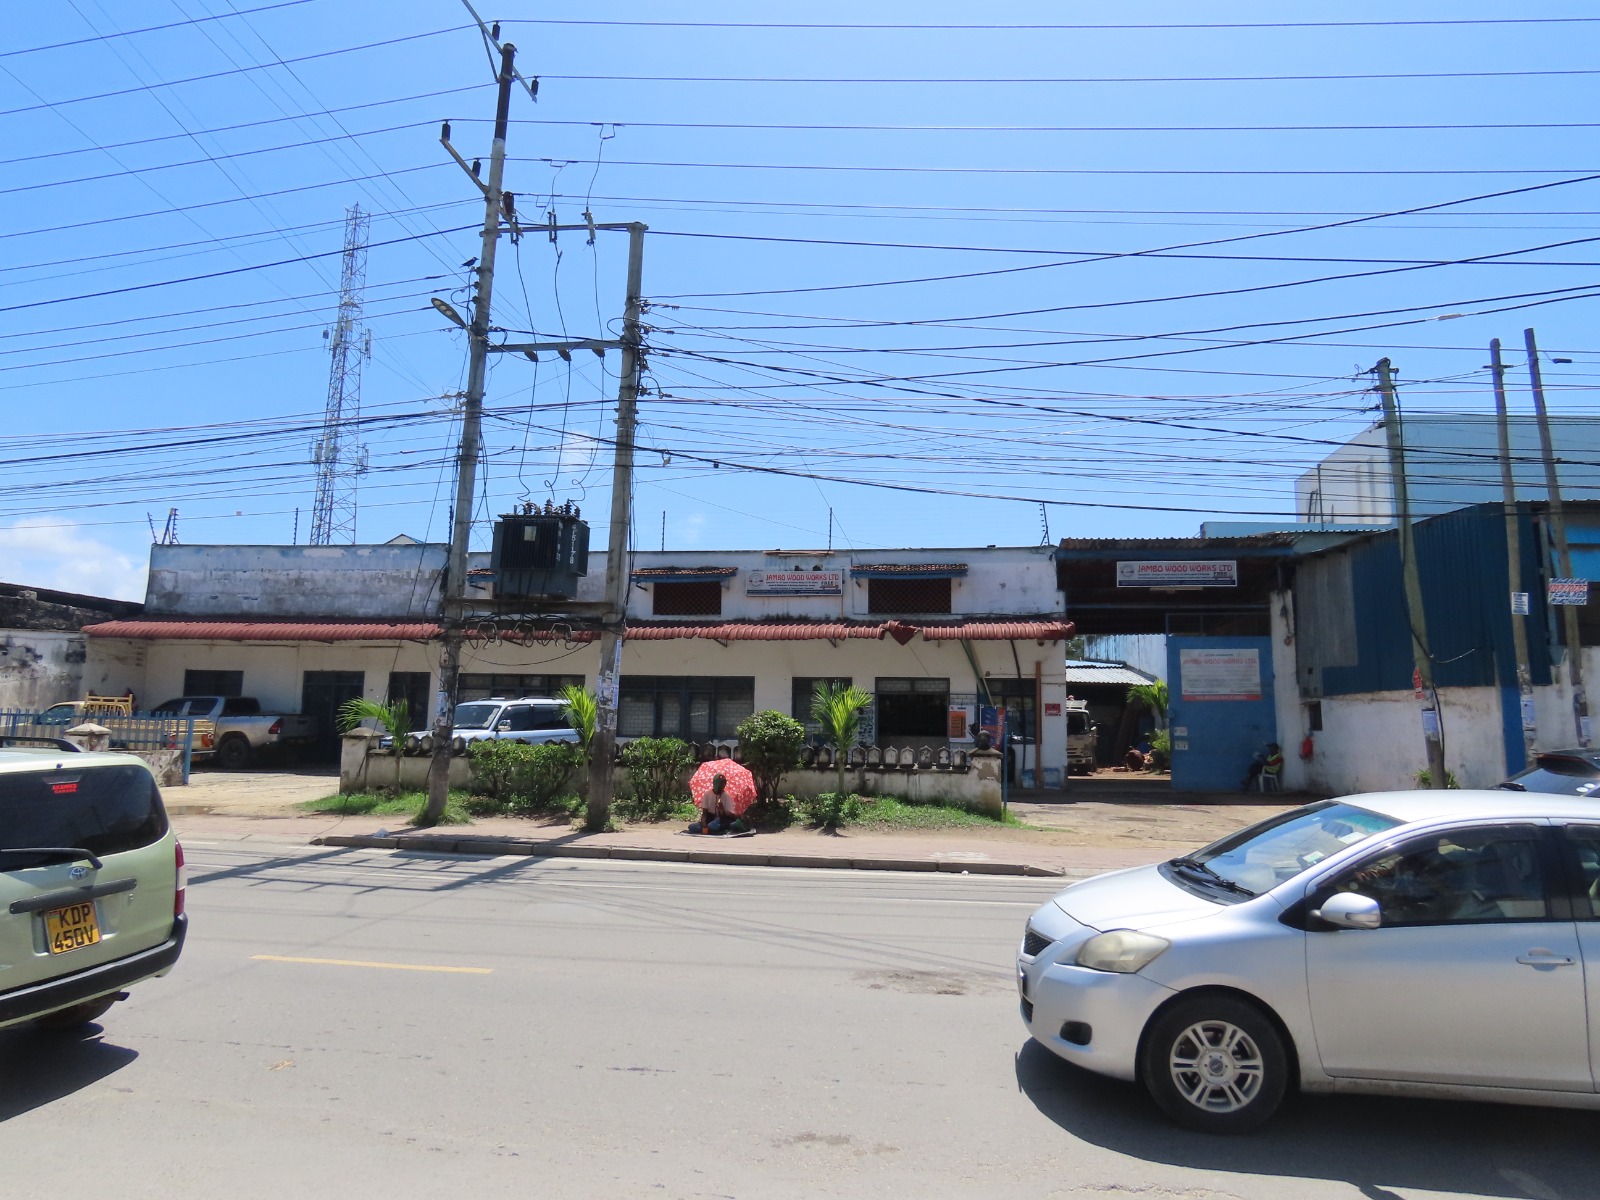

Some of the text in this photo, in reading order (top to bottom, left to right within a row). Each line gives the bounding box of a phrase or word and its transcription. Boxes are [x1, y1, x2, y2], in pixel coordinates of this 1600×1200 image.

[1189, 564, 1216, 572] WORKS
[1218, 564, 1233, 572] LTD
[59, 904, 91, 929] KDP
[54, 924, 94, 951] 450V
